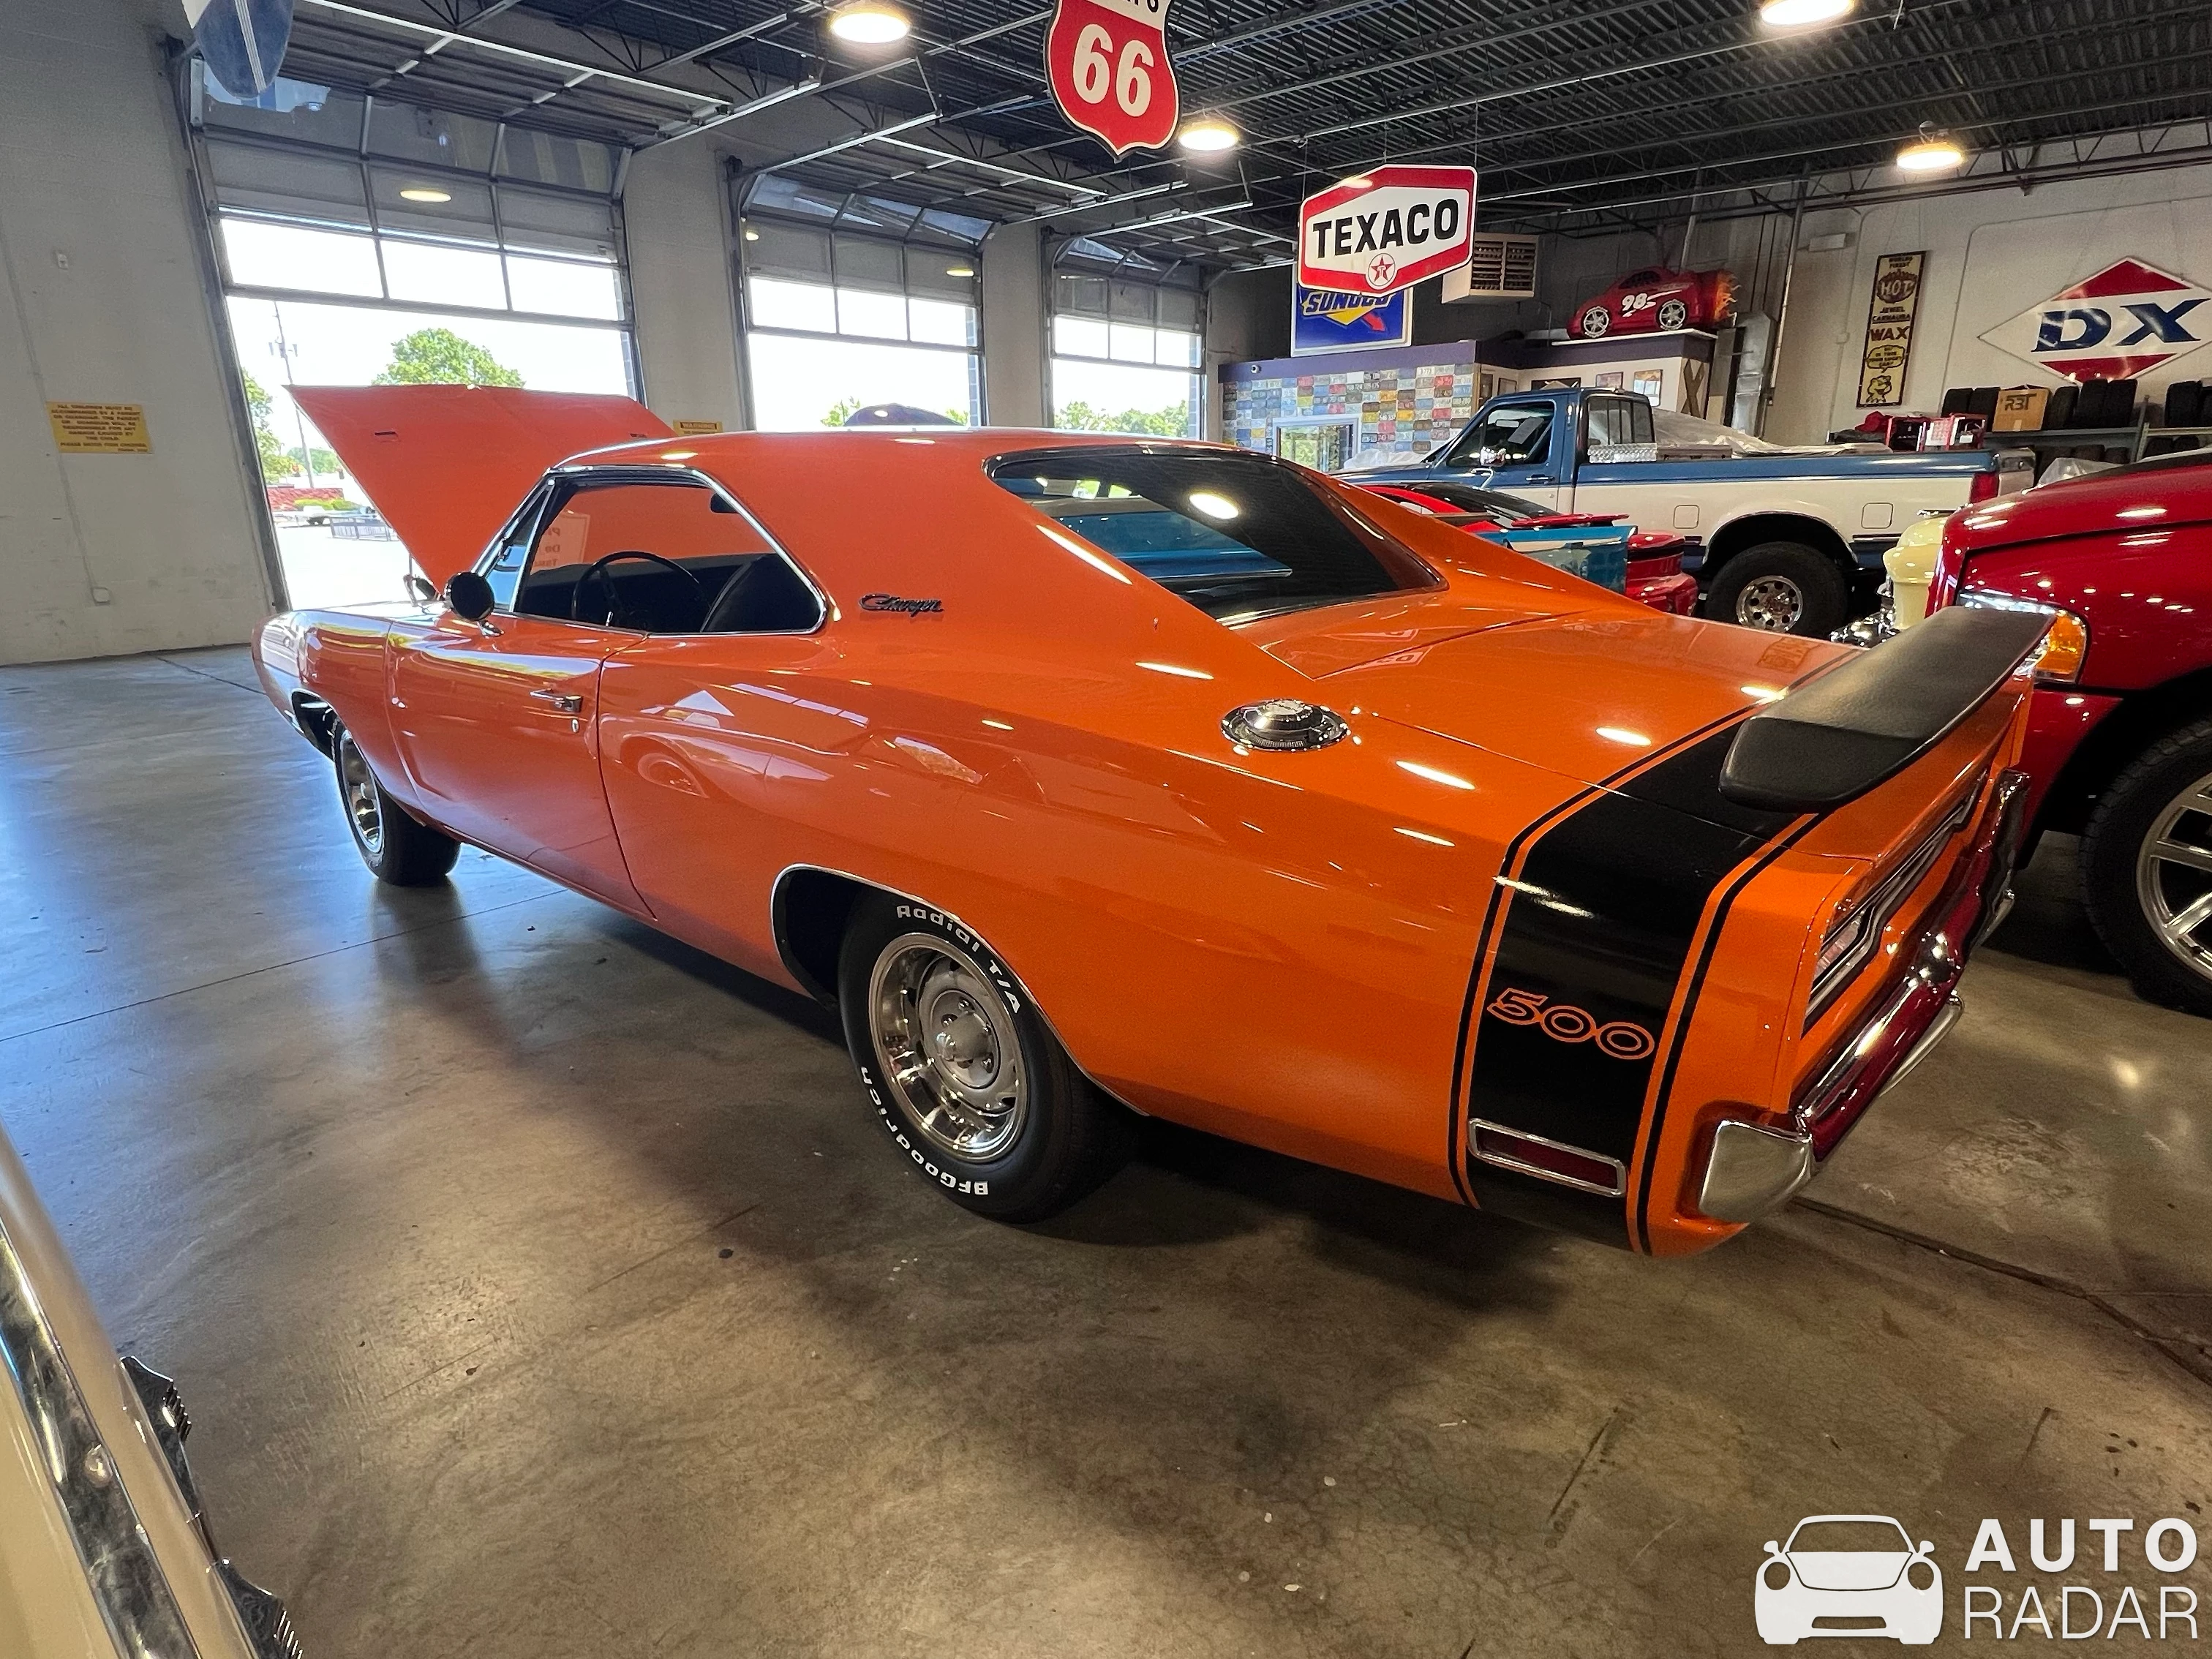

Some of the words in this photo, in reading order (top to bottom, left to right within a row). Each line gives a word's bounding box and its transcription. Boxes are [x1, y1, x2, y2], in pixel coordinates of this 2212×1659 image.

[1072, 23, 1154, 118] 66
[1312, 199, 1459, 259] TEXACO
[1622, 293, 1648, 312] 98
[1881, 279, 1914, 296] HOT
[1870, 326, 1911, 342] WAX
[2030, 297, 2212, 353] DX
[896, 904, 980, 953] Radial
[988, 958, 1022, 1015] T/A
[1486, 988, 1655, 1060] 500
